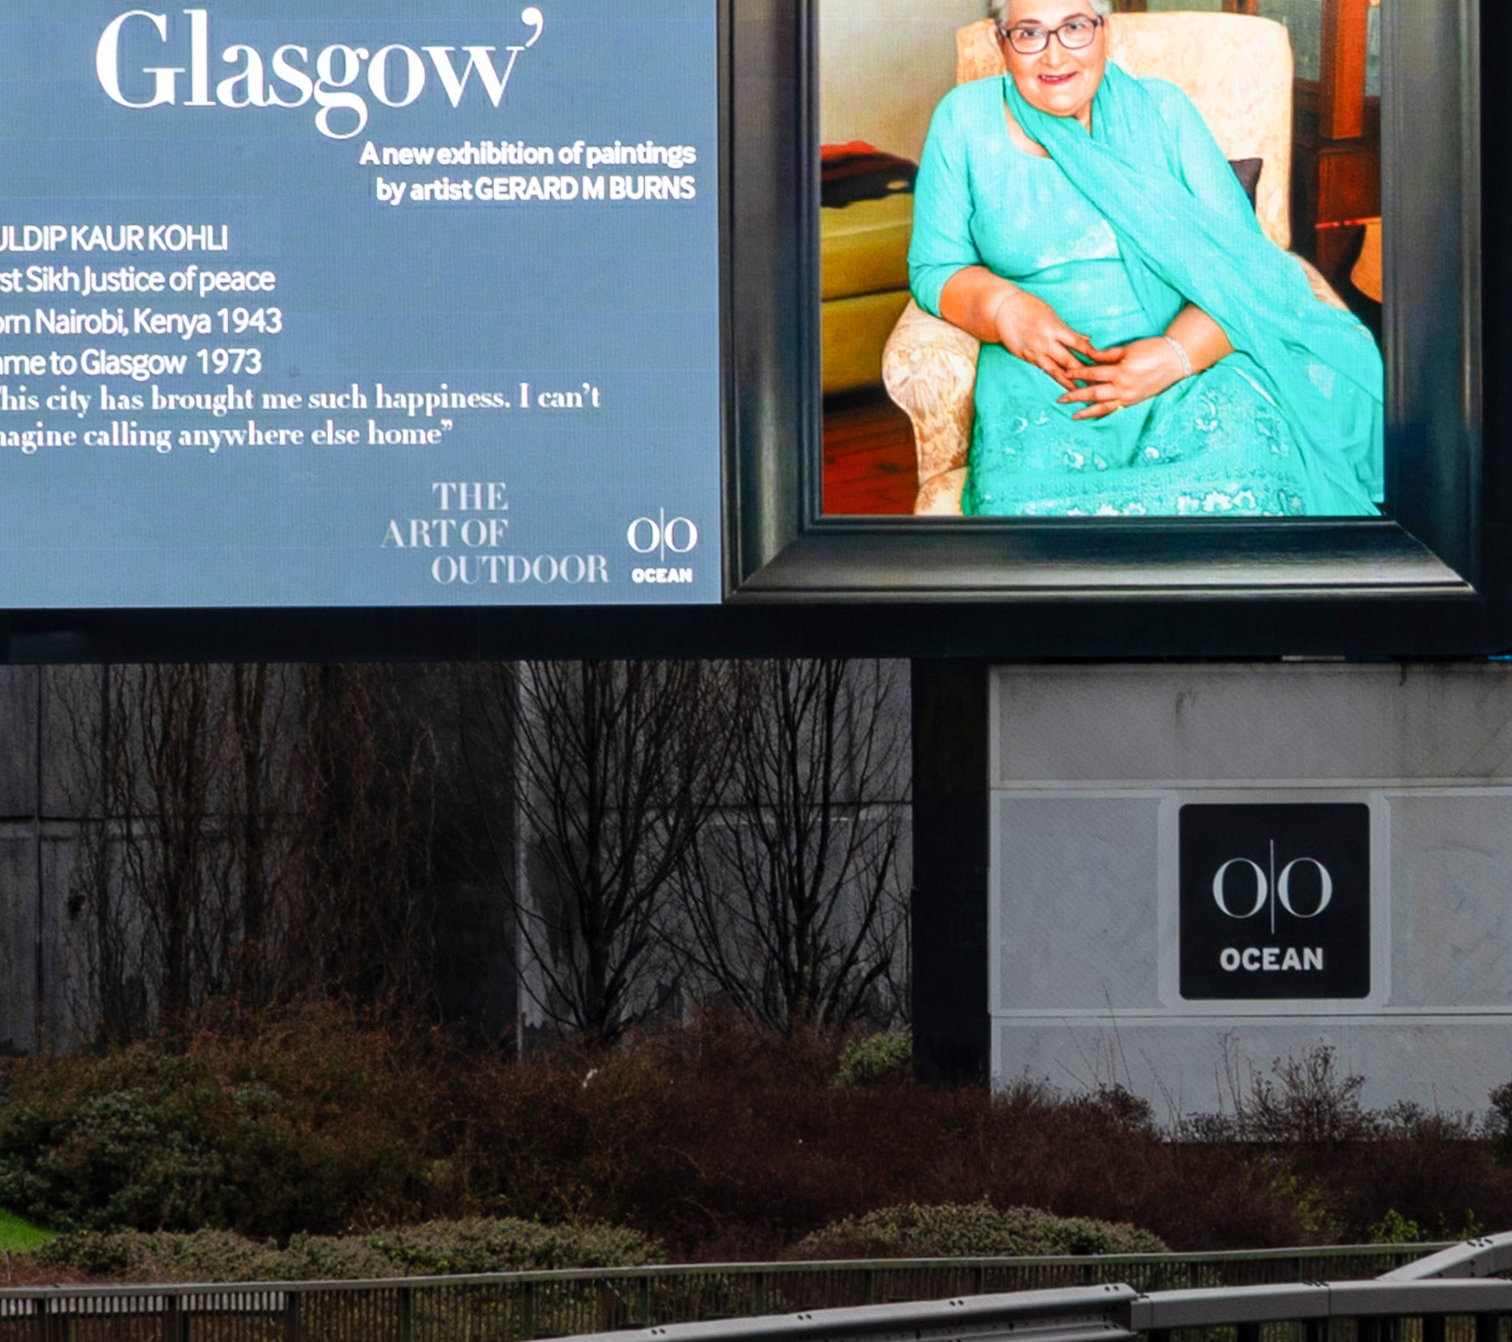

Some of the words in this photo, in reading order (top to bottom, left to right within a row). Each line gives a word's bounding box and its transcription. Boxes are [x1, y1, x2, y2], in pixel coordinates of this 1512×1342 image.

[95, 6, 544, 140] Glasgow’
[359, 140, 380, 165] A
[382, 147, 435, 165] new
[436, 140, 555, 165] exhibition
[558, 140, 586, 165] of
[586, 140, 697, 170] paintings
[376, 176, 407, 206] by
[409, 176, 474, 201] artist
[474, 175, 579, 201] GERARD
[582, 175, 605, 200] M
[609, 175, 696, 200] BURNS
[70, 224, 145, 252] KAUR
[148, 224, 228, 252] KOHLI
[26, 265, 80, 293] Sikh
[81, 265, 166, 297] Justice
[169, 264, 199, 292] of
[199, 270, 276, 298] peace
[35, 307, 129, 337] Nairobi,
[133, 307, 212, 341] Kenya
[217, 307, 283, 334] 1943
[48, 351, 78, 376] to
[80, 348, 188, 382] Glasgow
[196, 347, 262, 375] 1973
[46, 384, 92, 419] city
[100, 384, 144, 411] has
[151, 384, 253, 417] brought
[262, 393, 303, 410] me
[307, 383, 368, 409] such
[375, 383, 511, 417] happiness.
[518, 382, 530, 408] I
[537, 382, 600, 408] can’t
[83, 420, 172, 454] calling
[178, 419, 305, 454] anywhere
[311, 419, 360, 445] else
[432, 482, 509, 511] THE
[380, 518, 456, 548] ART
[461, 518, 509, 547] OF
[431, 554, 609, 584] OUTDOOR
[631, 567, 693, 584] OCEAN
[1220, 947, 1323, 971] OCEAN
